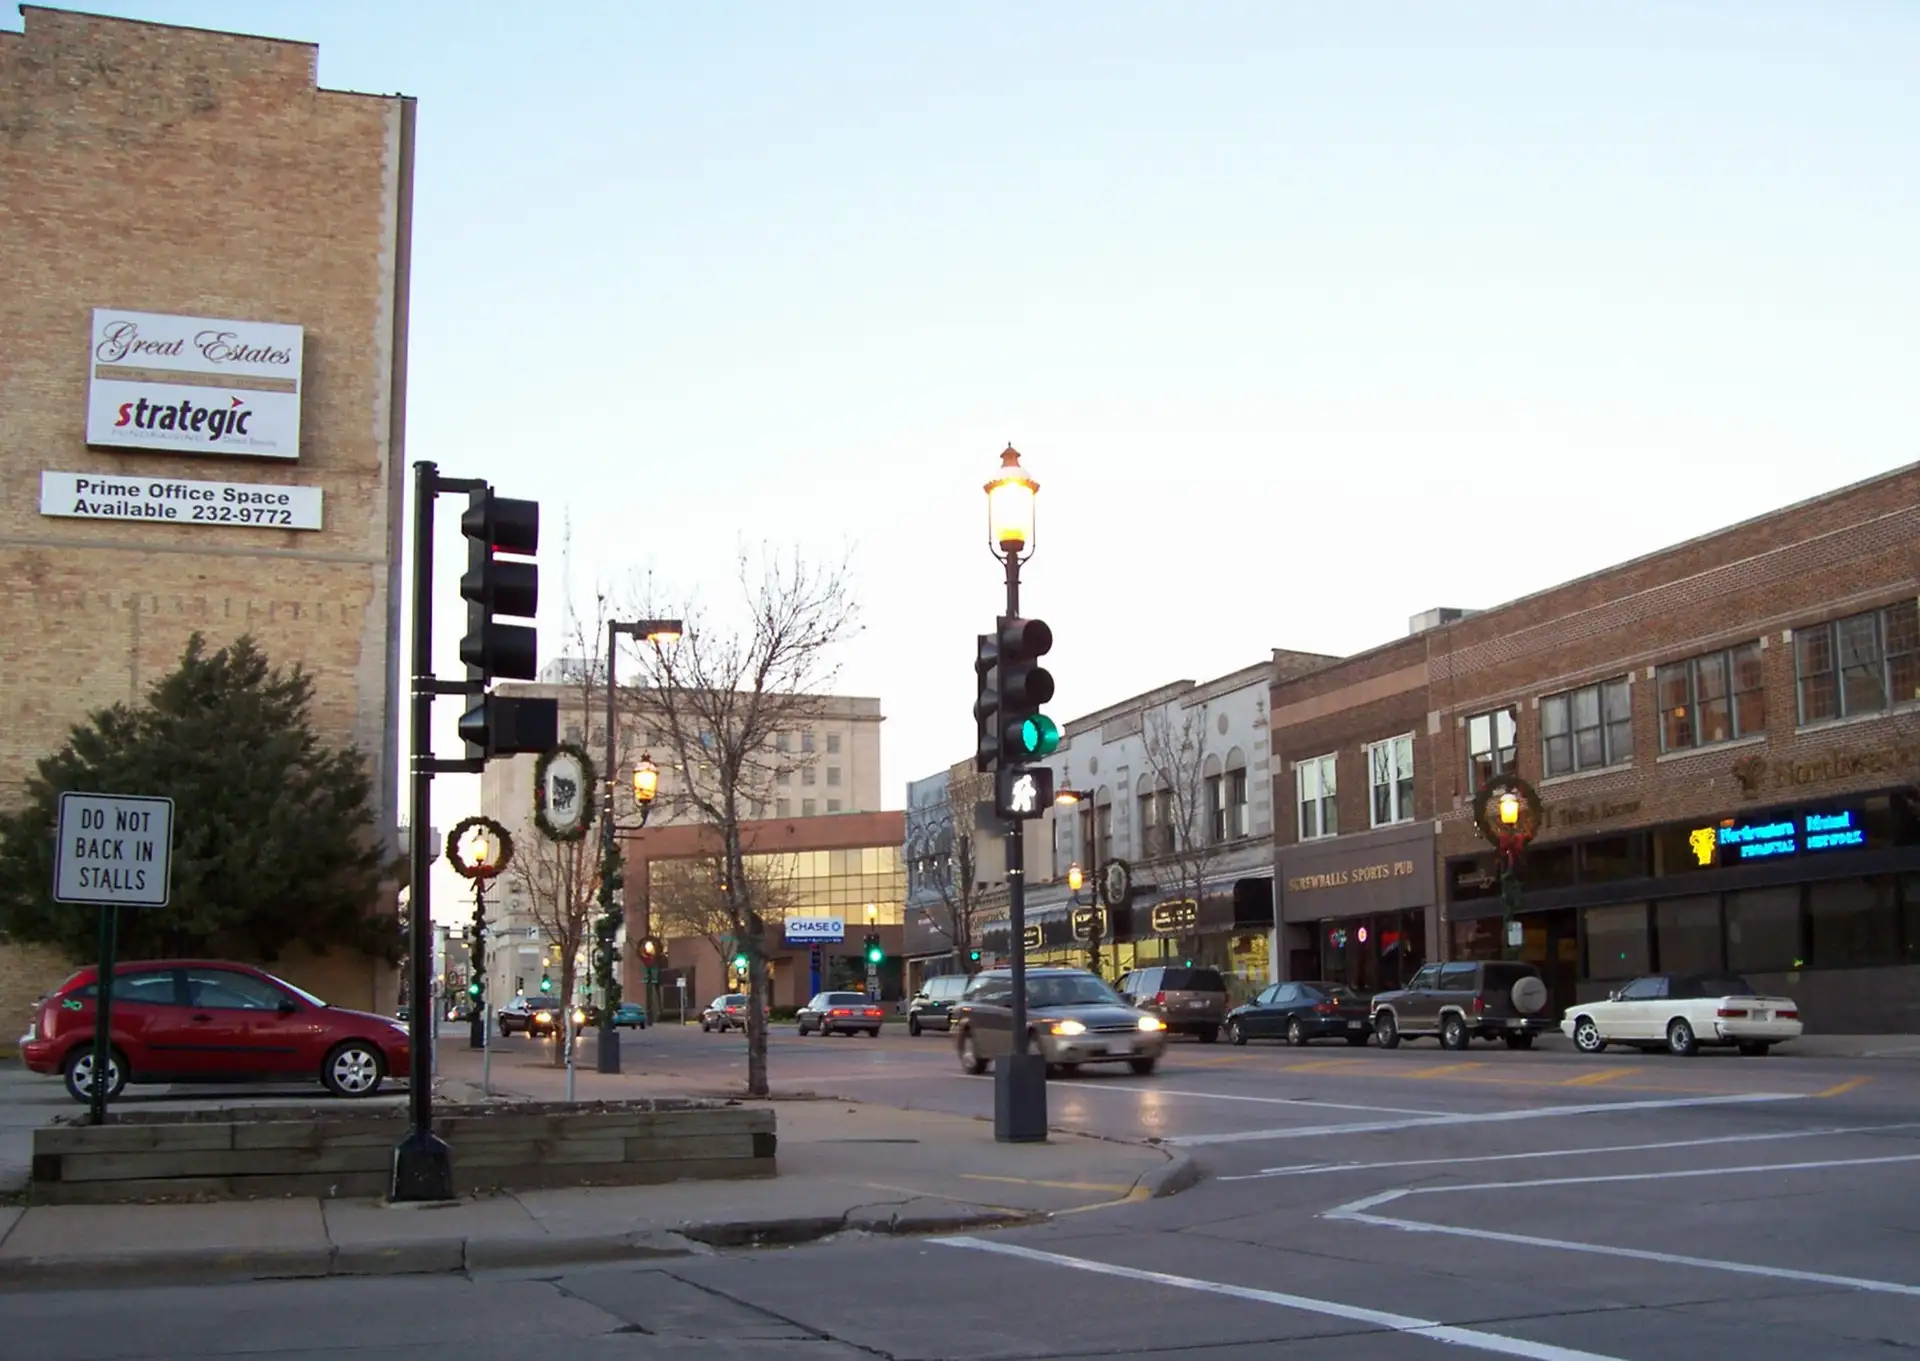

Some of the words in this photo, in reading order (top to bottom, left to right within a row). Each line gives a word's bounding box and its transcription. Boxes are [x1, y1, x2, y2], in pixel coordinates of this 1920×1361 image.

[96, 321, 184, 362] Great
[194, 330, 291, 364] Estates
[115, 397, 252, 441] strategic
[76, 479, 140, 497] Prime
[149, 483, 215, 501] Office
[223, 488, 290, 506] Space
[73, 499, 178, 518] Available
[192, 505, 292, 525] 232-9772
[81, 808, 104, 830] DO
[116, 808, 151, 832] NOT
[76, 837, 123, 860] BACK
[136, 840, 153, 862] IN
[79, 867, 146, 891] STALLS
[1351, 864, 1389, 883] SPORTS
[1394, 860, 1414, 876] PUB
[791, 922, 829, 932] CHASE
